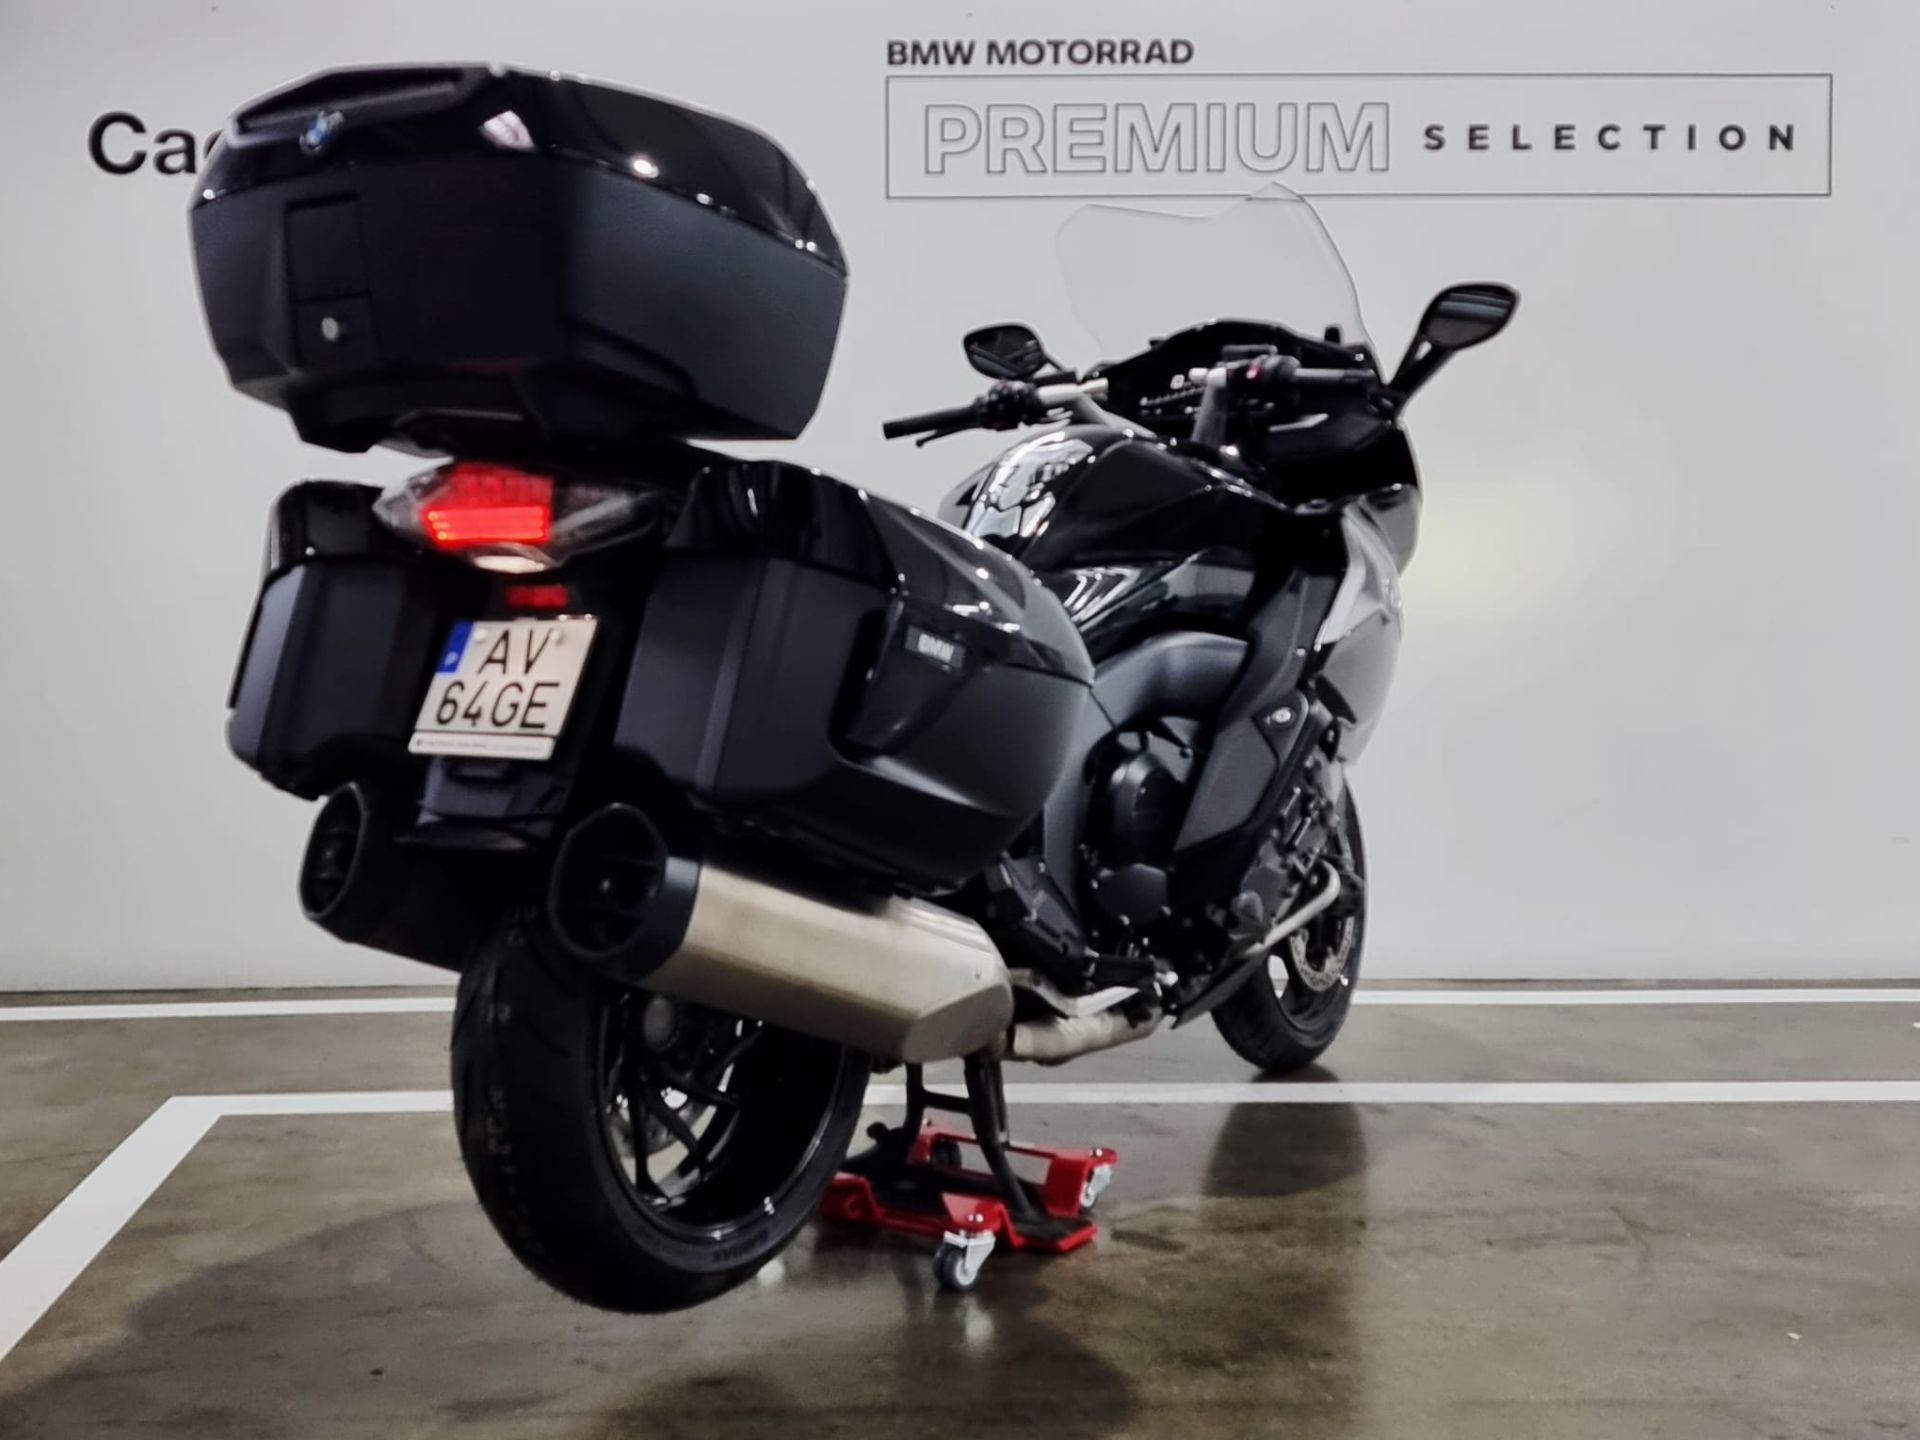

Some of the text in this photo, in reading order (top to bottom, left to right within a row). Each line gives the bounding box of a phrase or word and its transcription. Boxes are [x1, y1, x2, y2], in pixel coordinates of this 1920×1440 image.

[887, 39, 1195, 65] BMW MOTORRAD
[88, 110, 224, 175] Ca
[924, 102, 1796, 175] PREMIUM SELECTION
[476, 628, 551, 675] AV
[435, 680, 561, 729] 64GE
